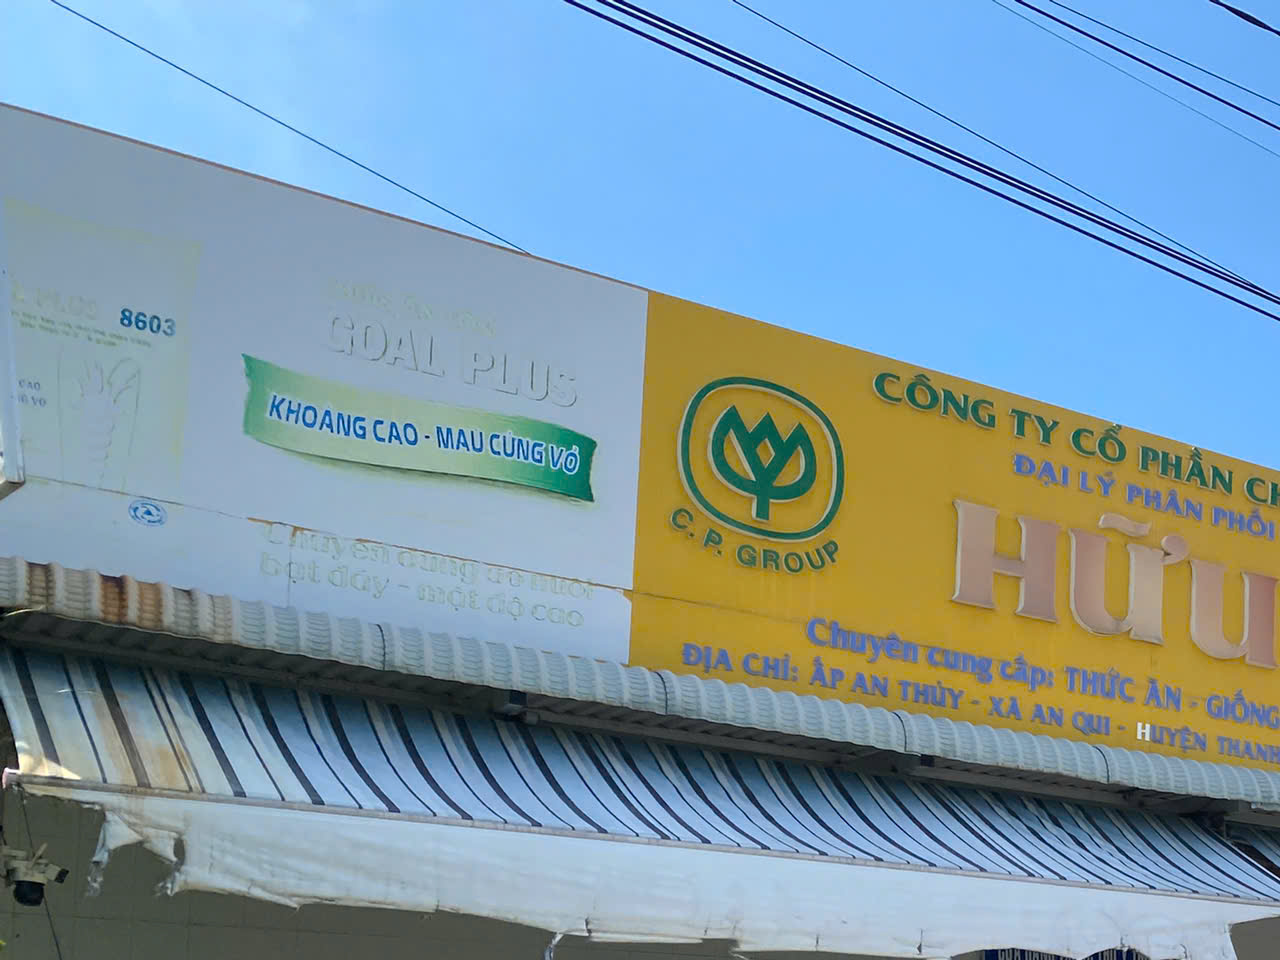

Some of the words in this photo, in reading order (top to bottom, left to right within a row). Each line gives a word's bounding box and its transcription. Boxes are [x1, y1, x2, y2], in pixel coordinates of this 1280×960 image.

[118, 307, 176, 337] 8603
[372, 419, 418, 447] CAO
[872, 371, 996, 429] CÔNG
[1009, 408, 1060, 446] TY
[1070, 423, 1127, 464] CỔ
[1137, 446, 1234, 496] PHẦN
[1013, 452, 1070, 487] ĐẠI
[1079, 470, 1116, 497] LÝ
[1126, 483, 1203, 521] PHÂN
[1212, 504, 1276, 541] PHỐI
[735, 540, 839, 574] GROUP
[952, 499, 1280, 670] HỮU
[681, 642, 734, 675] ĐỊA
[809, 656, 846, 690] ẤP
[851, 671, 890, 698] AN
[1031, 703, 1065, 728] AN
[1071, 710, 1111, 736] QUI
[1136, 722, 1207, 752] HUYỆN
[806, 616, 919, 665] Chuyên
[926, 644, 994, 684] cung
[1064, 666, 1136, 704] THỨC
[1144, 678, 1183, 713] ĂN
[1205, 689, 1280, 730] GIỐNG
